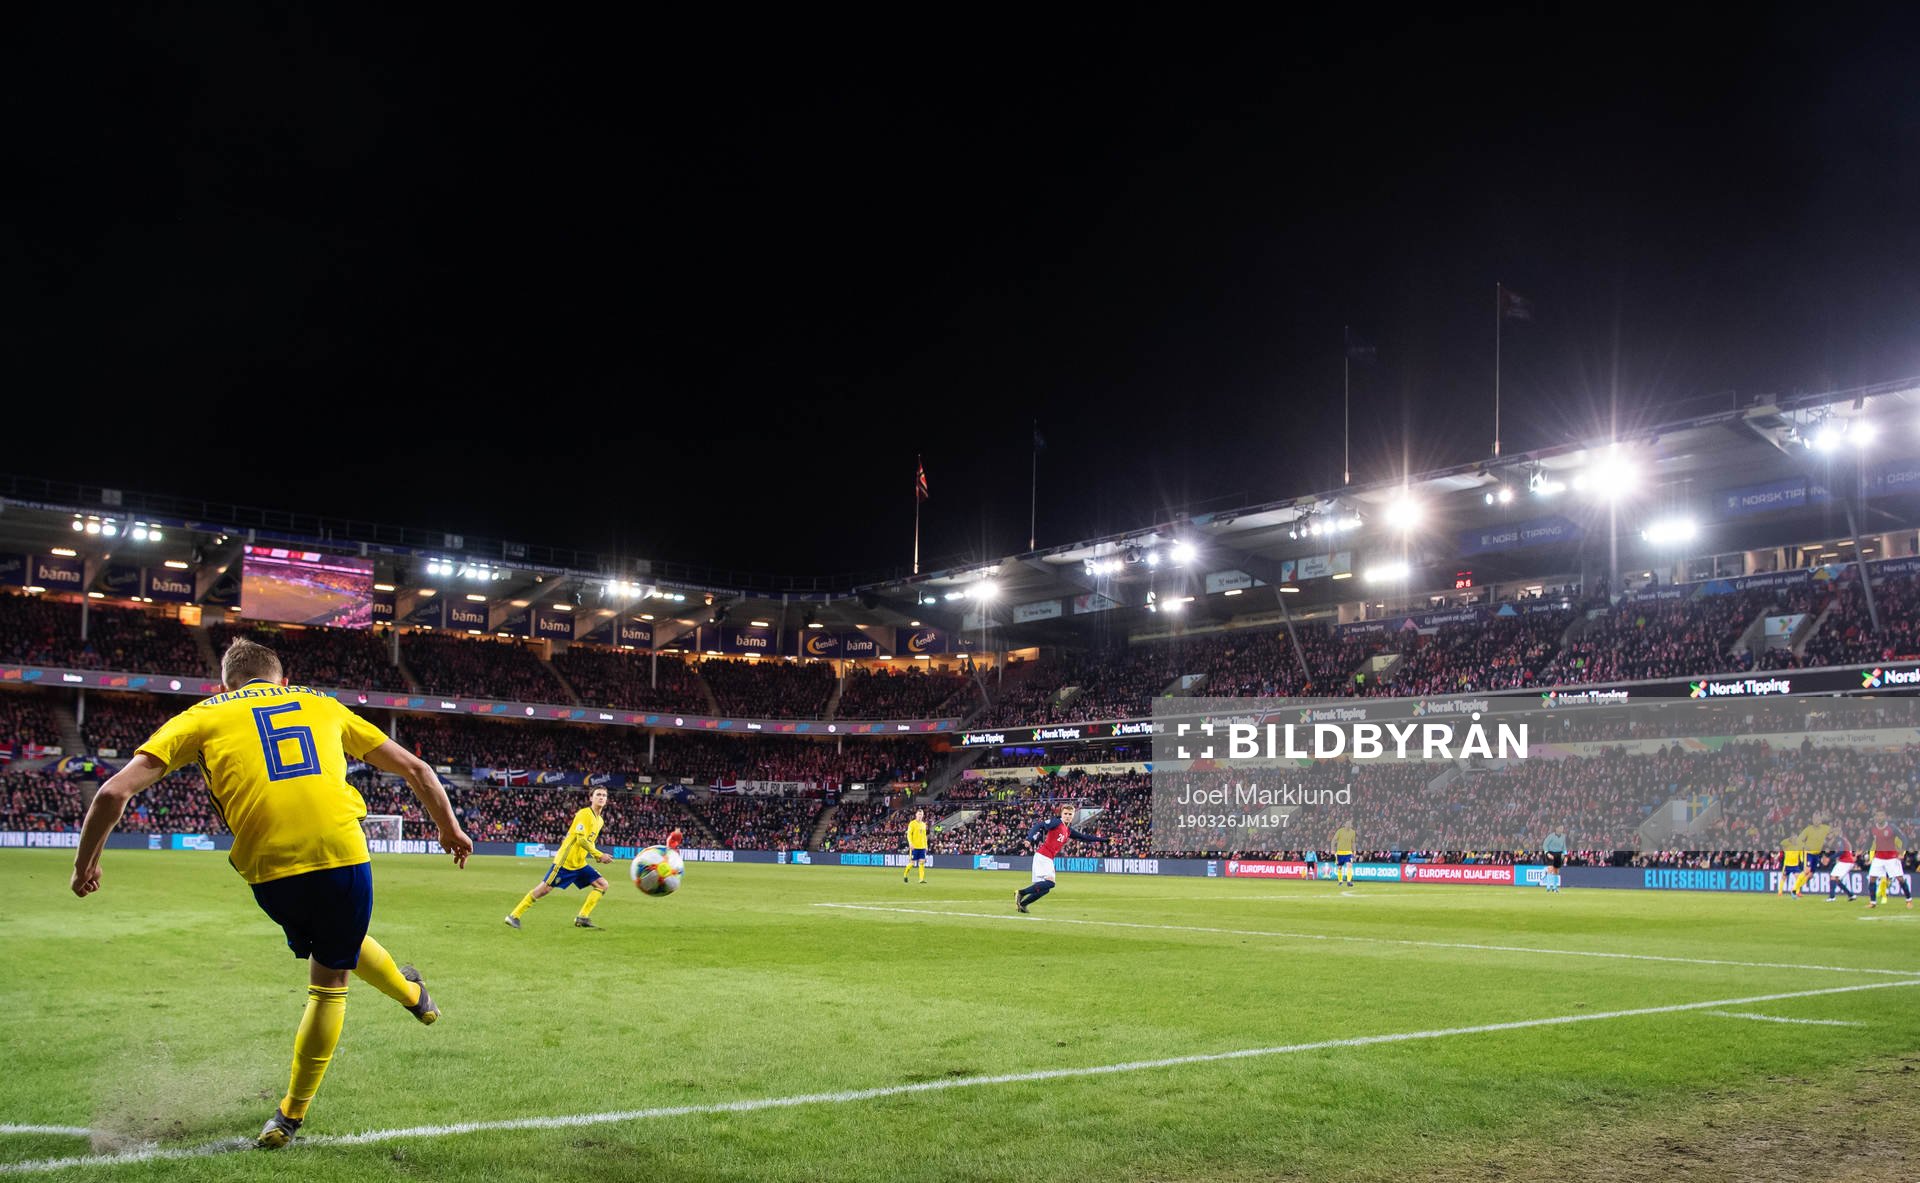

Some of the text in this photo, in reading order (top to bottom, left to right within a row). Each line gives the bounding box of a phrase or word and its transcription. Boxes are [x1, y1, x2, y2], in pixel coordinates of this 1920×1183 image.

[1742, 492, 1782, 506] NORSK
[39, 565, 81, 582] bama
[152, 577, 191, 594] bama
[374, 602, 393, 614] ma
[452, 609, 484, 624] bama
[540, 618, 570, 633] bama
[622, 627, 650, 640] bama
[914, 632, 936, 648] Bendit
[736, 635, 767, 647] bama
[815, 638, 839, 650] Bendit
[846, 640, 873, 651] bama
[1709, 679, 1790, 696] Norsk Tipping
[1558, 689, 1629, 705] Norsk Tipping
[1428, 698, 1488, 713] Norsk Tipping
[1312, 708, 1366, 721] Norsk Tipping
[1212, 716, 1232, 727] Norsk
[1041, 728, 1080, 739] Norsk Tipping
[1122, 723, 1165, 734] Norsk Tipping
[252, 701, 322, 781] 6
[970, 733, 1005, 743] Norsk Tipping
[1822, 733, 1876, 743] Norsk Tipping
[544, 772, 565, 784] Bendit
[591, 772, 611, 785] Bendit
[27, 832, 79, 847] PREMIER
[369, 840, 388, 853] FRA
[613, 847, 635, 858] SPILL
[679, 849, 734, 862] VINN PREMIER
[1067, 857, 1098, 872] FANTASY
[1104, 858, 1123, 873] VINN
[1124, 859, 1158, 874] PREMIER
[1240, 864, 1275, 874] EUROPEAN
[1355, 867, 1376, 877] EURO
[1377, 867, 1399, 877] 2020
[1419, 868, 1511, 880] EUROPEAN QUALIFIERS
[1644, 869, 1727, 889] ELITESERIEN
[1729, 871, 1765, 891] 2019
